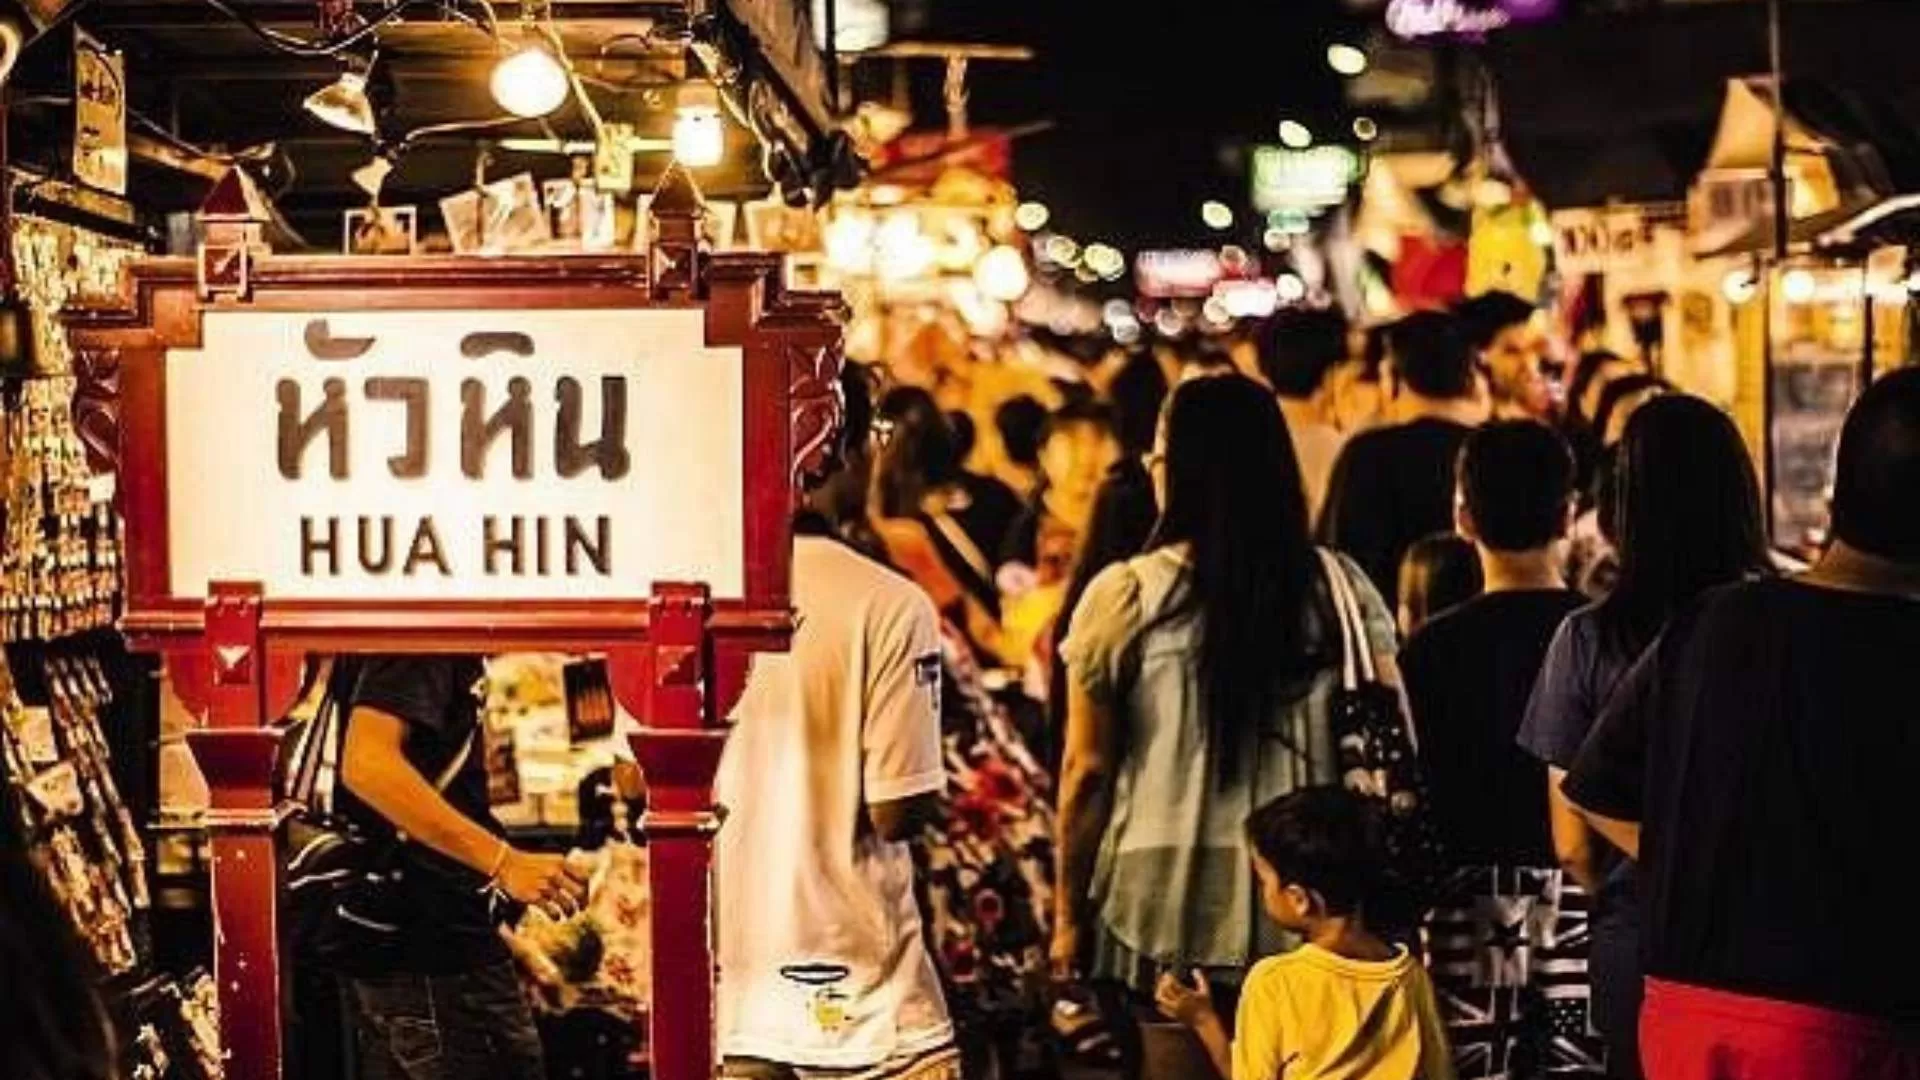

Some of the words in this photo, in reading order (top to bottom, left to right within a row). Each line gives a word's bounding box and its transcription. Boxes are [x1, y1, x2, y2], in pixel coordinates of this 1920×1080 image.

[275, 319, 632, 482] หัวหิน
[299, 515, 452, 577] HUA
[482, 515, 612, 577] HIN
